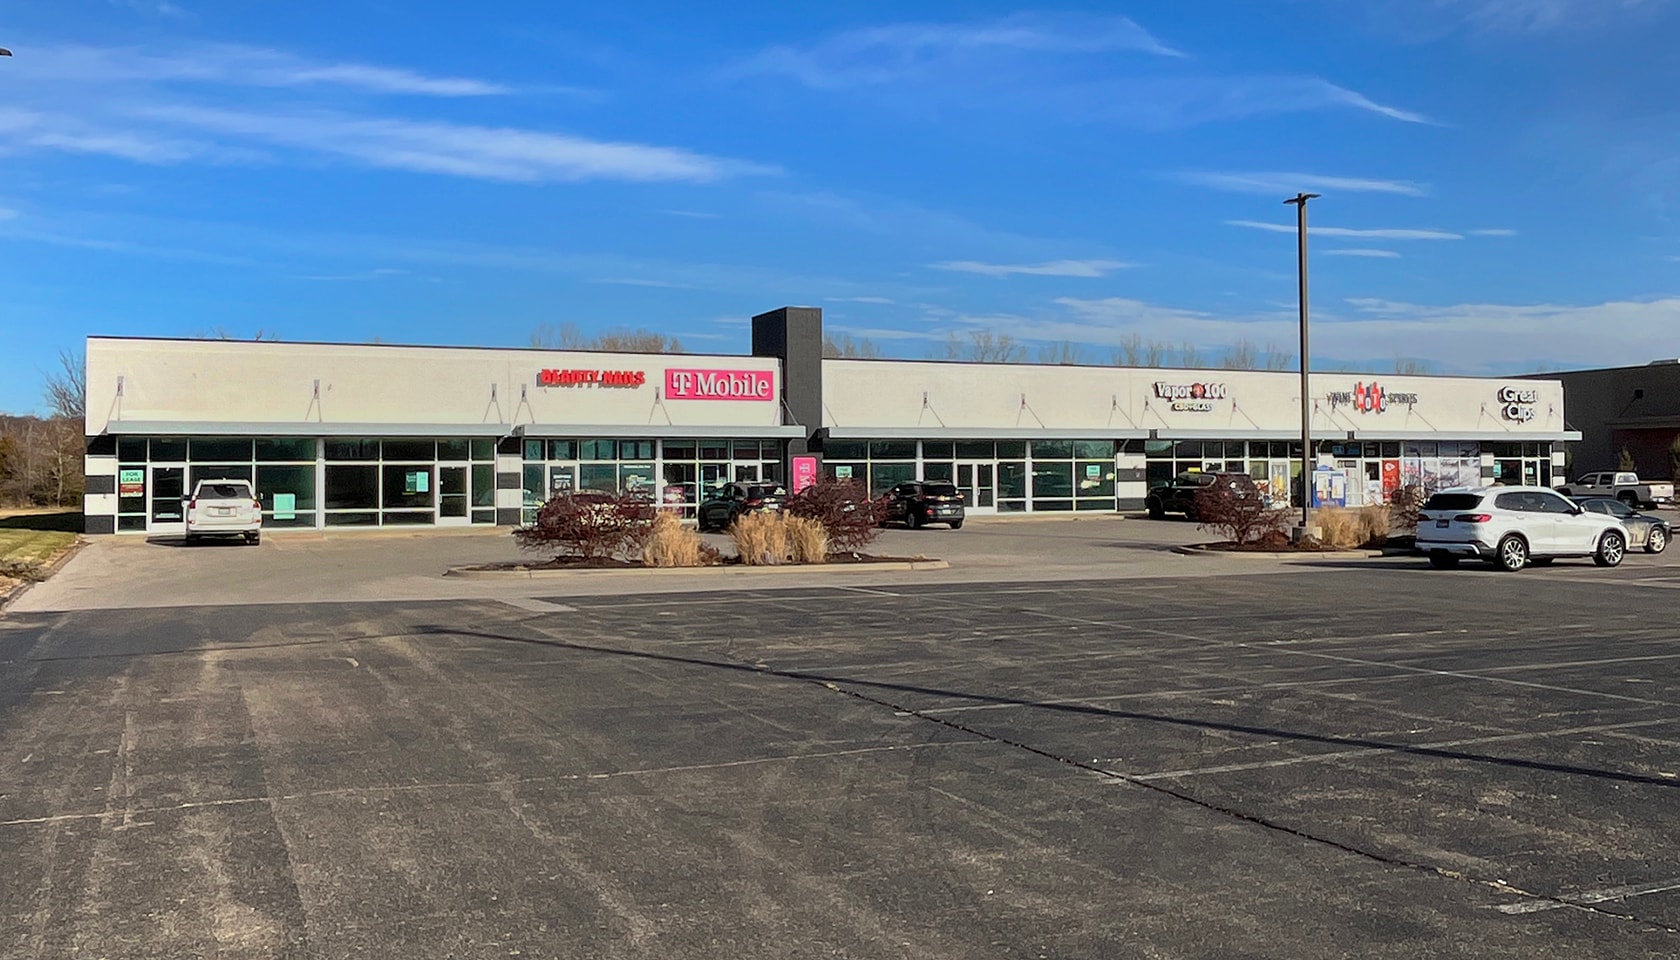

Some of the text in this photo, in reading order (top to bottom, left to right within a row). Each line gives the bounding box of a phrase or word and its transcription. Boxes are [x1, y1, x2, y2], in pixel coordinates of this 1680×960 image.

[541, 369, 646, 386] BEAUTY NAILS
[1154, 382, 1228, 401] Vapor 100
[1502, 386, 1538, 403] Great
[1506, 403, 1536, 422] Clips
